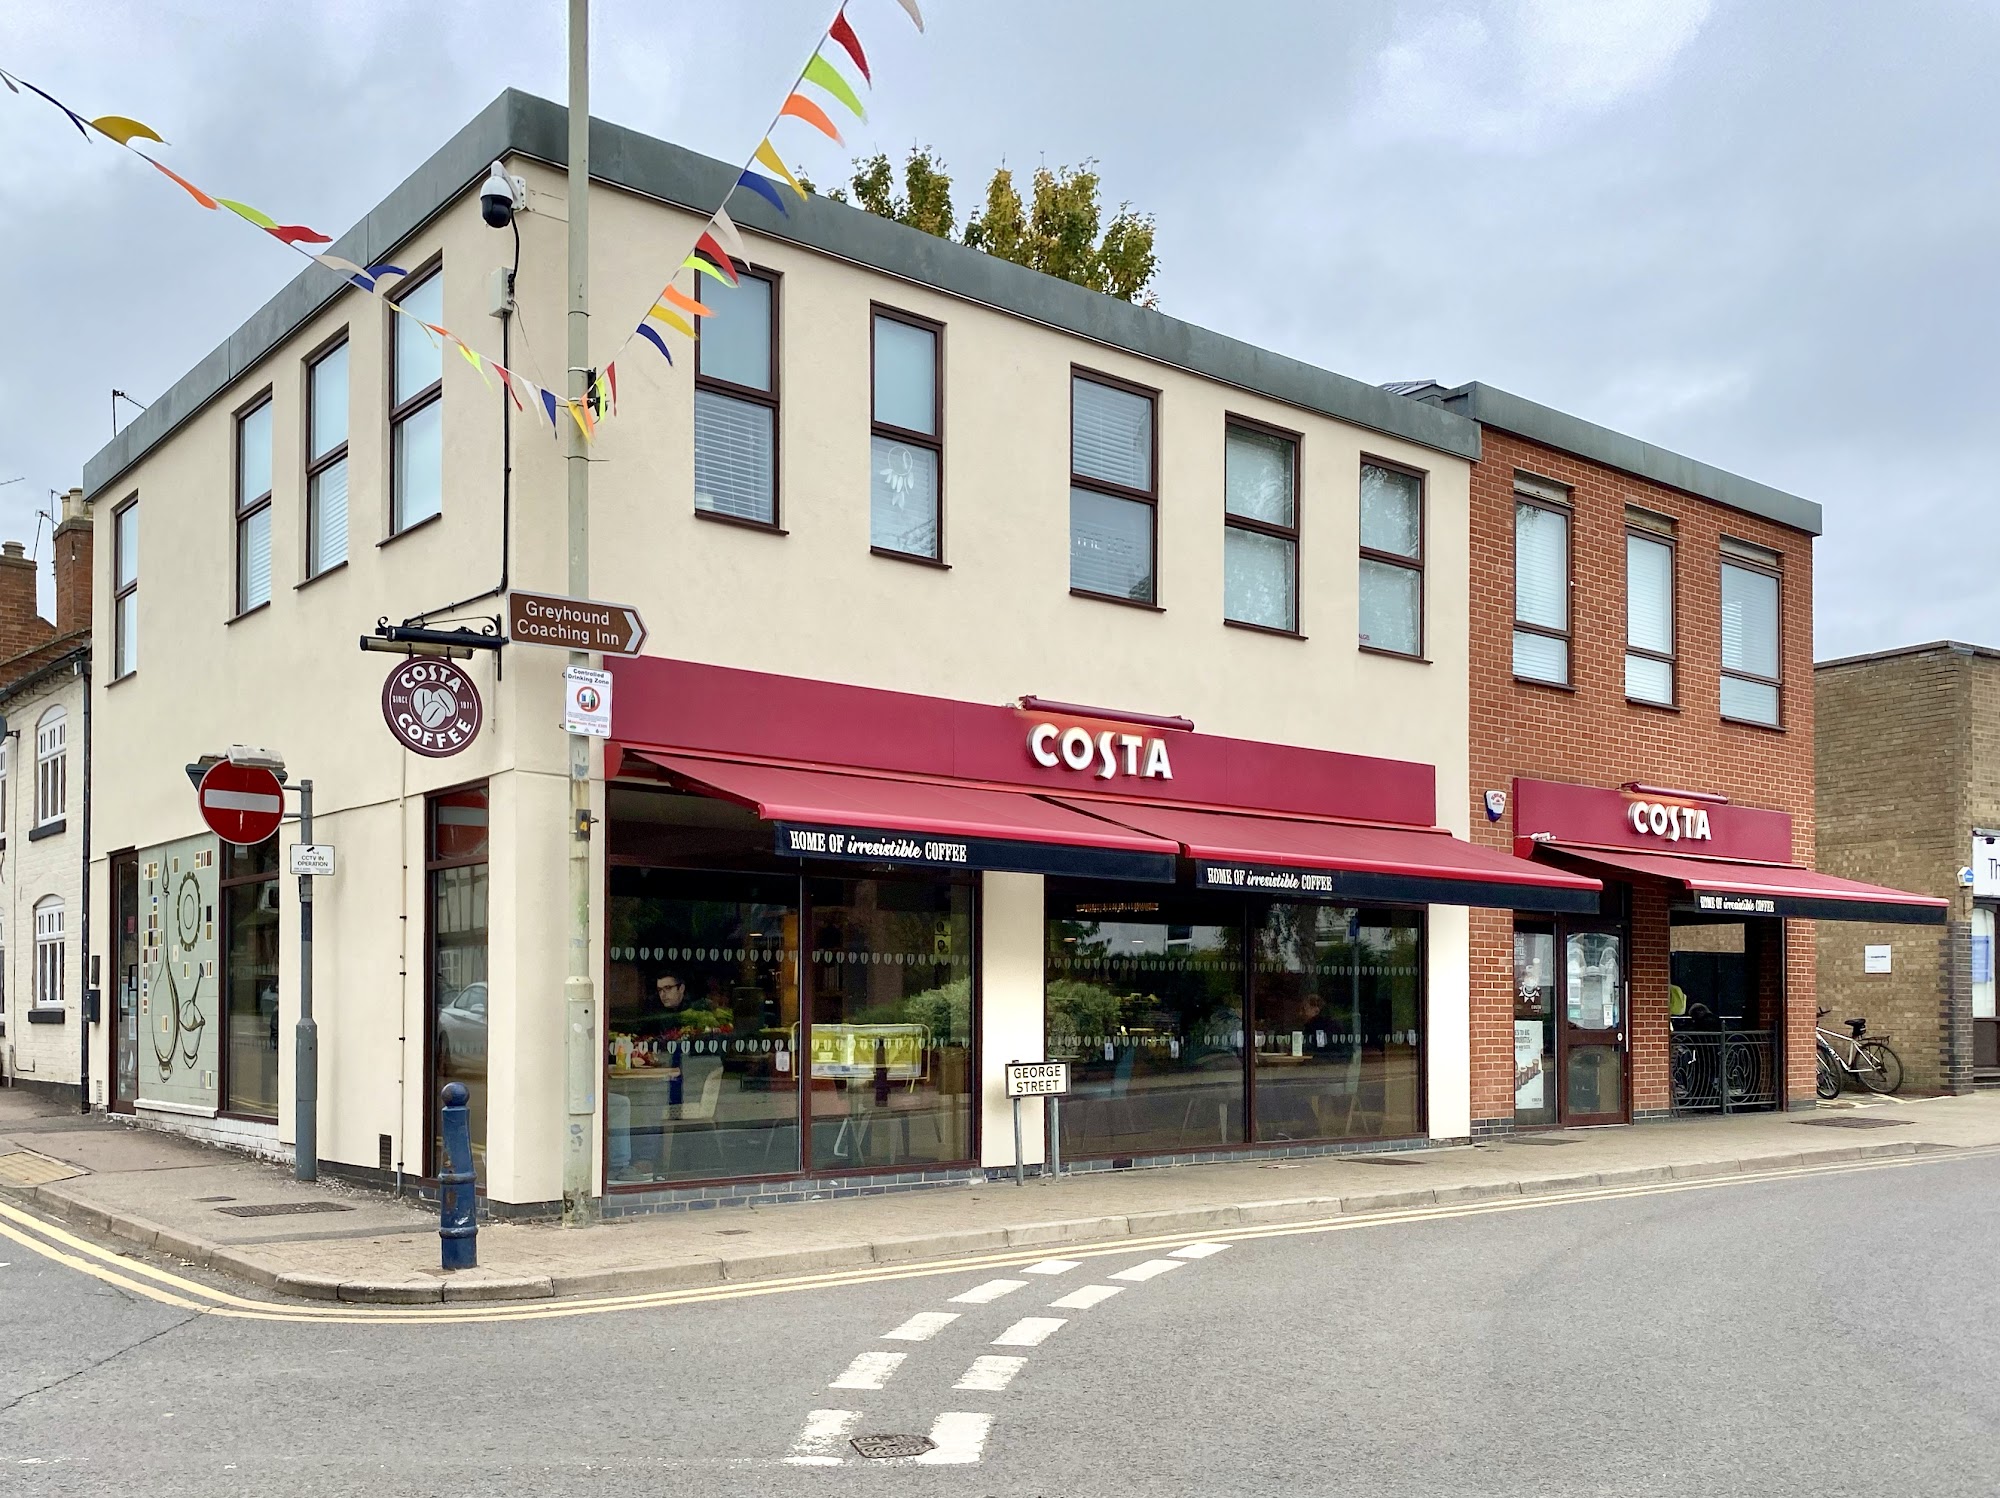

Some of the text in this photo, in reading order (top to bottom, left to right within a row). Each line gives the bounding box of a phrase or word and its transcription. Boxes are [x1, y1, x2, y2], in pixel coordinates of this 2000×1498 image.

[525, 600, 609, 625] Greyhound
[517, 618, 619, 645] Coaching Inn
[401, 665, 461, 693] COSTA
[568, 673, 593, 684] Drinking
[573, 668, 605, 679] Controlled
[398, 713, 472, 748] COFFEE
[1026, 722, 1174, 780] COSTA
[579, 821, 588, 832] 4
[1628, 801, 1712, 842] COSTA
[790, 830, 967, 862] HOME OF irresistible COFFEE
[1207, 867, 1333, 891] HOME OF irresistible COFFEE
[1014, 1065, 1061, 1079] GEORGE
[1016, 1079, 1060, 1093] STREET
